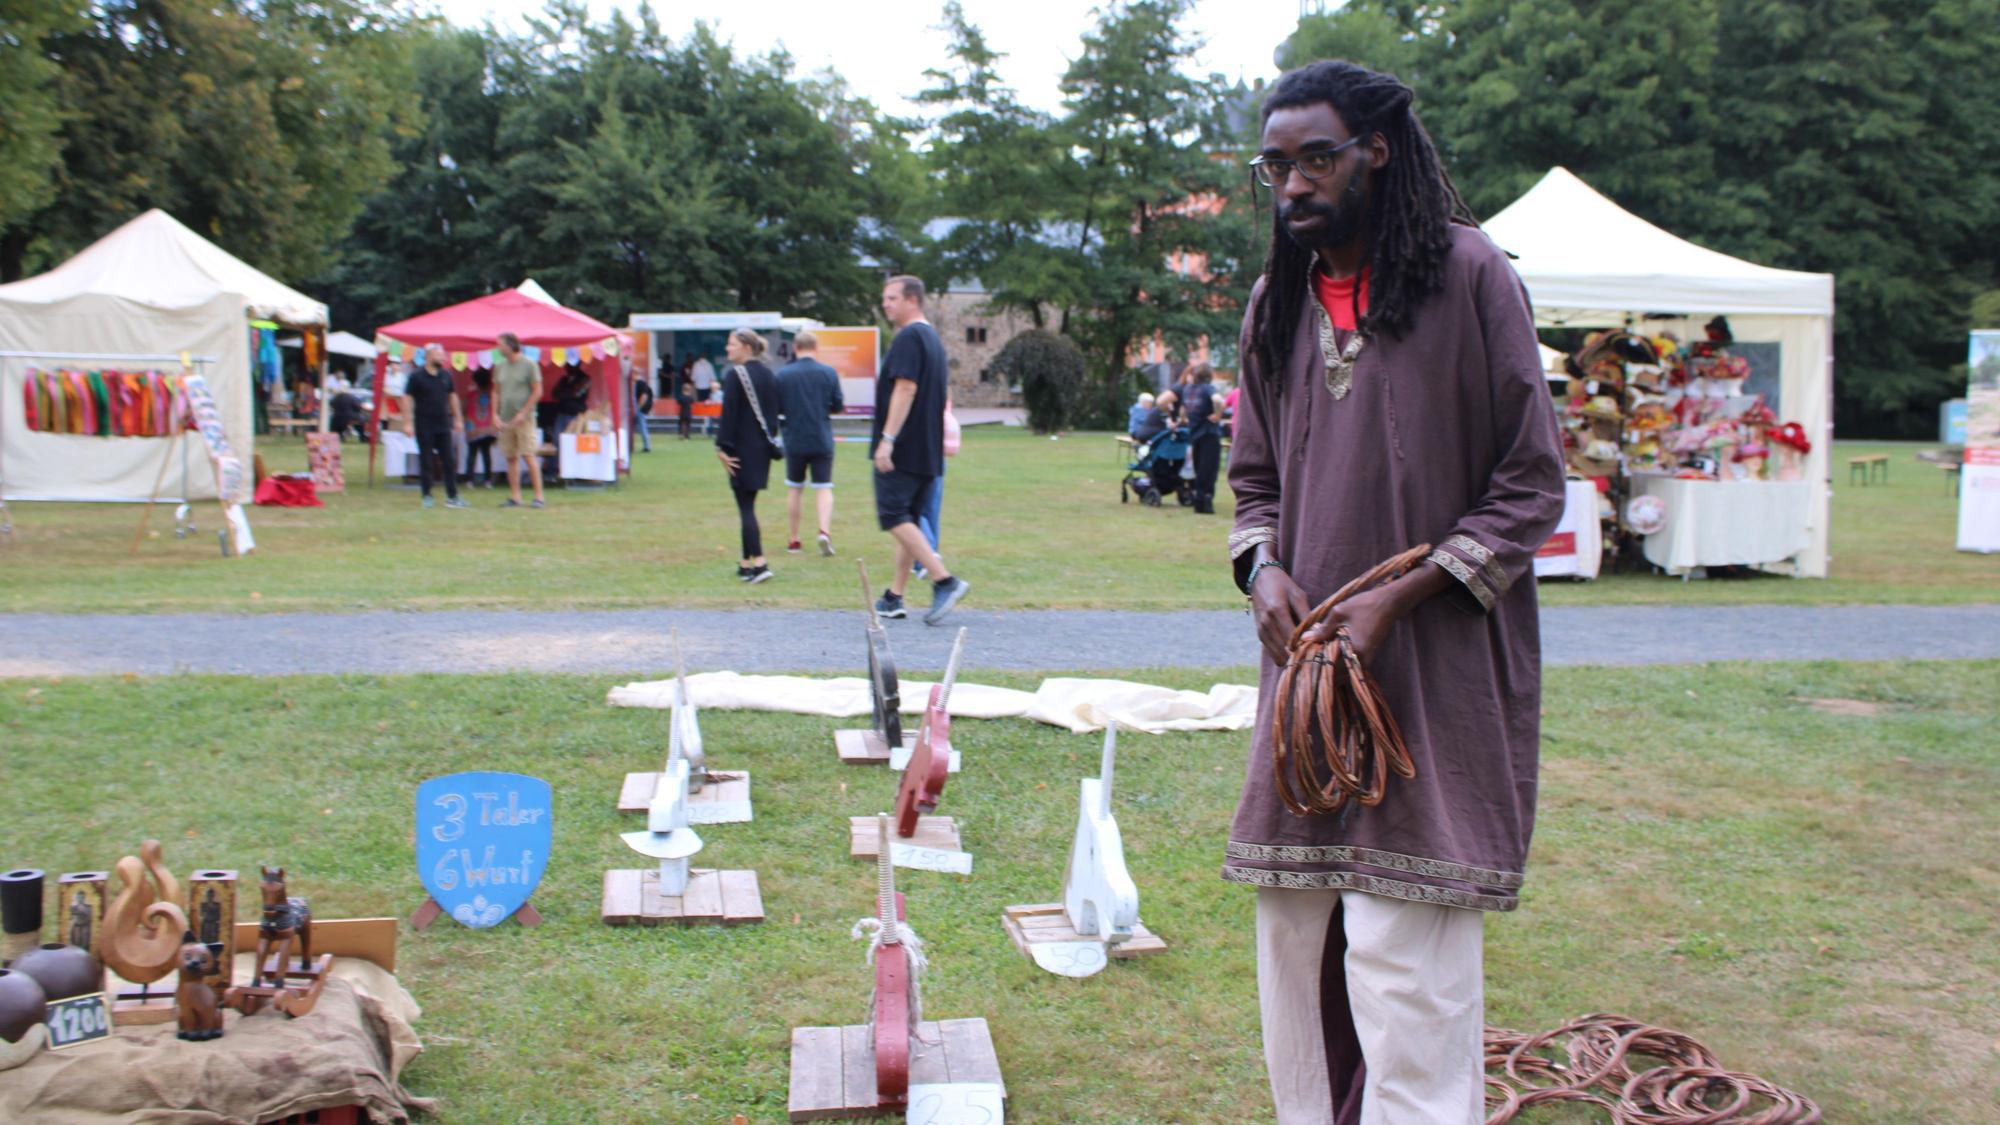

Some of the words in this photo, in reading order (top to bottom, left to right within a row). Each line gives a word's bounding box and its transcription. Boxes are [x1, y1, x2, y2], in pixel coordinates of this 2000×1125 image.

[431, 793, 468, 842] 3
[433, 848, 459, 892] 6
[1050, 946, 1101, 968] 50
